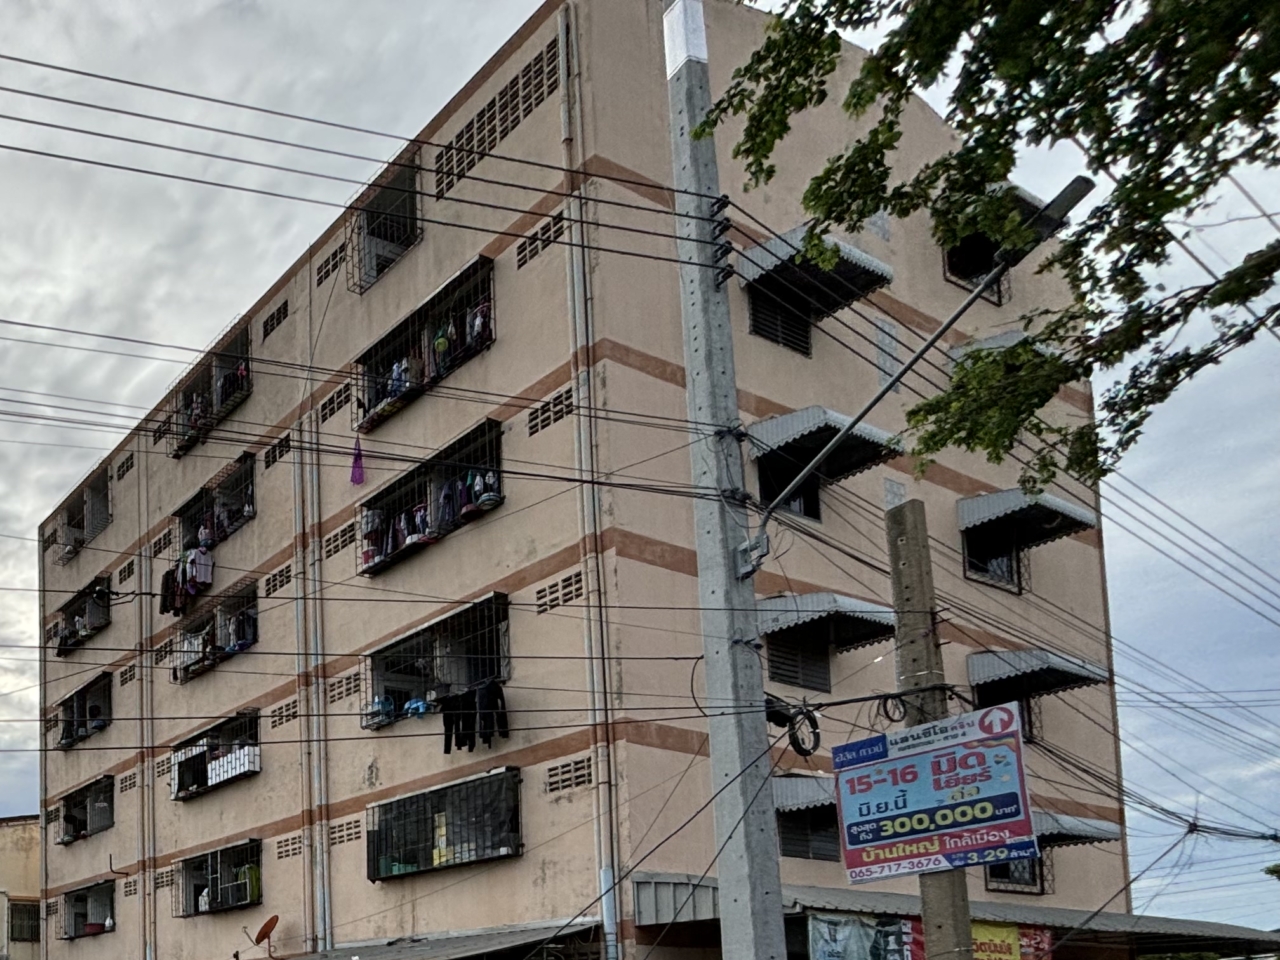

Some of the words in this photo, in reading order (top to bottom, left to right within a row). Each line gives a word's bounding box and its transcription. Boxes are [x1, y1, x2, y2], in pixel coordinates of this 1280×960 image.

[889, 724, 949, 746] แลนซีโอ
[845, 763, 919, 796] 15-16
[850, 822, 877, 835] สูงสุด
[878, 801, 994, 837] 300,000
[861, 838, 940, 863] บ้านใหญ่
[943, 828, 1010, 849] ใกล้เมือง
[967, 847, 1009, 864] 3.29
[849, 856, 942, 880] 065-717-3676
